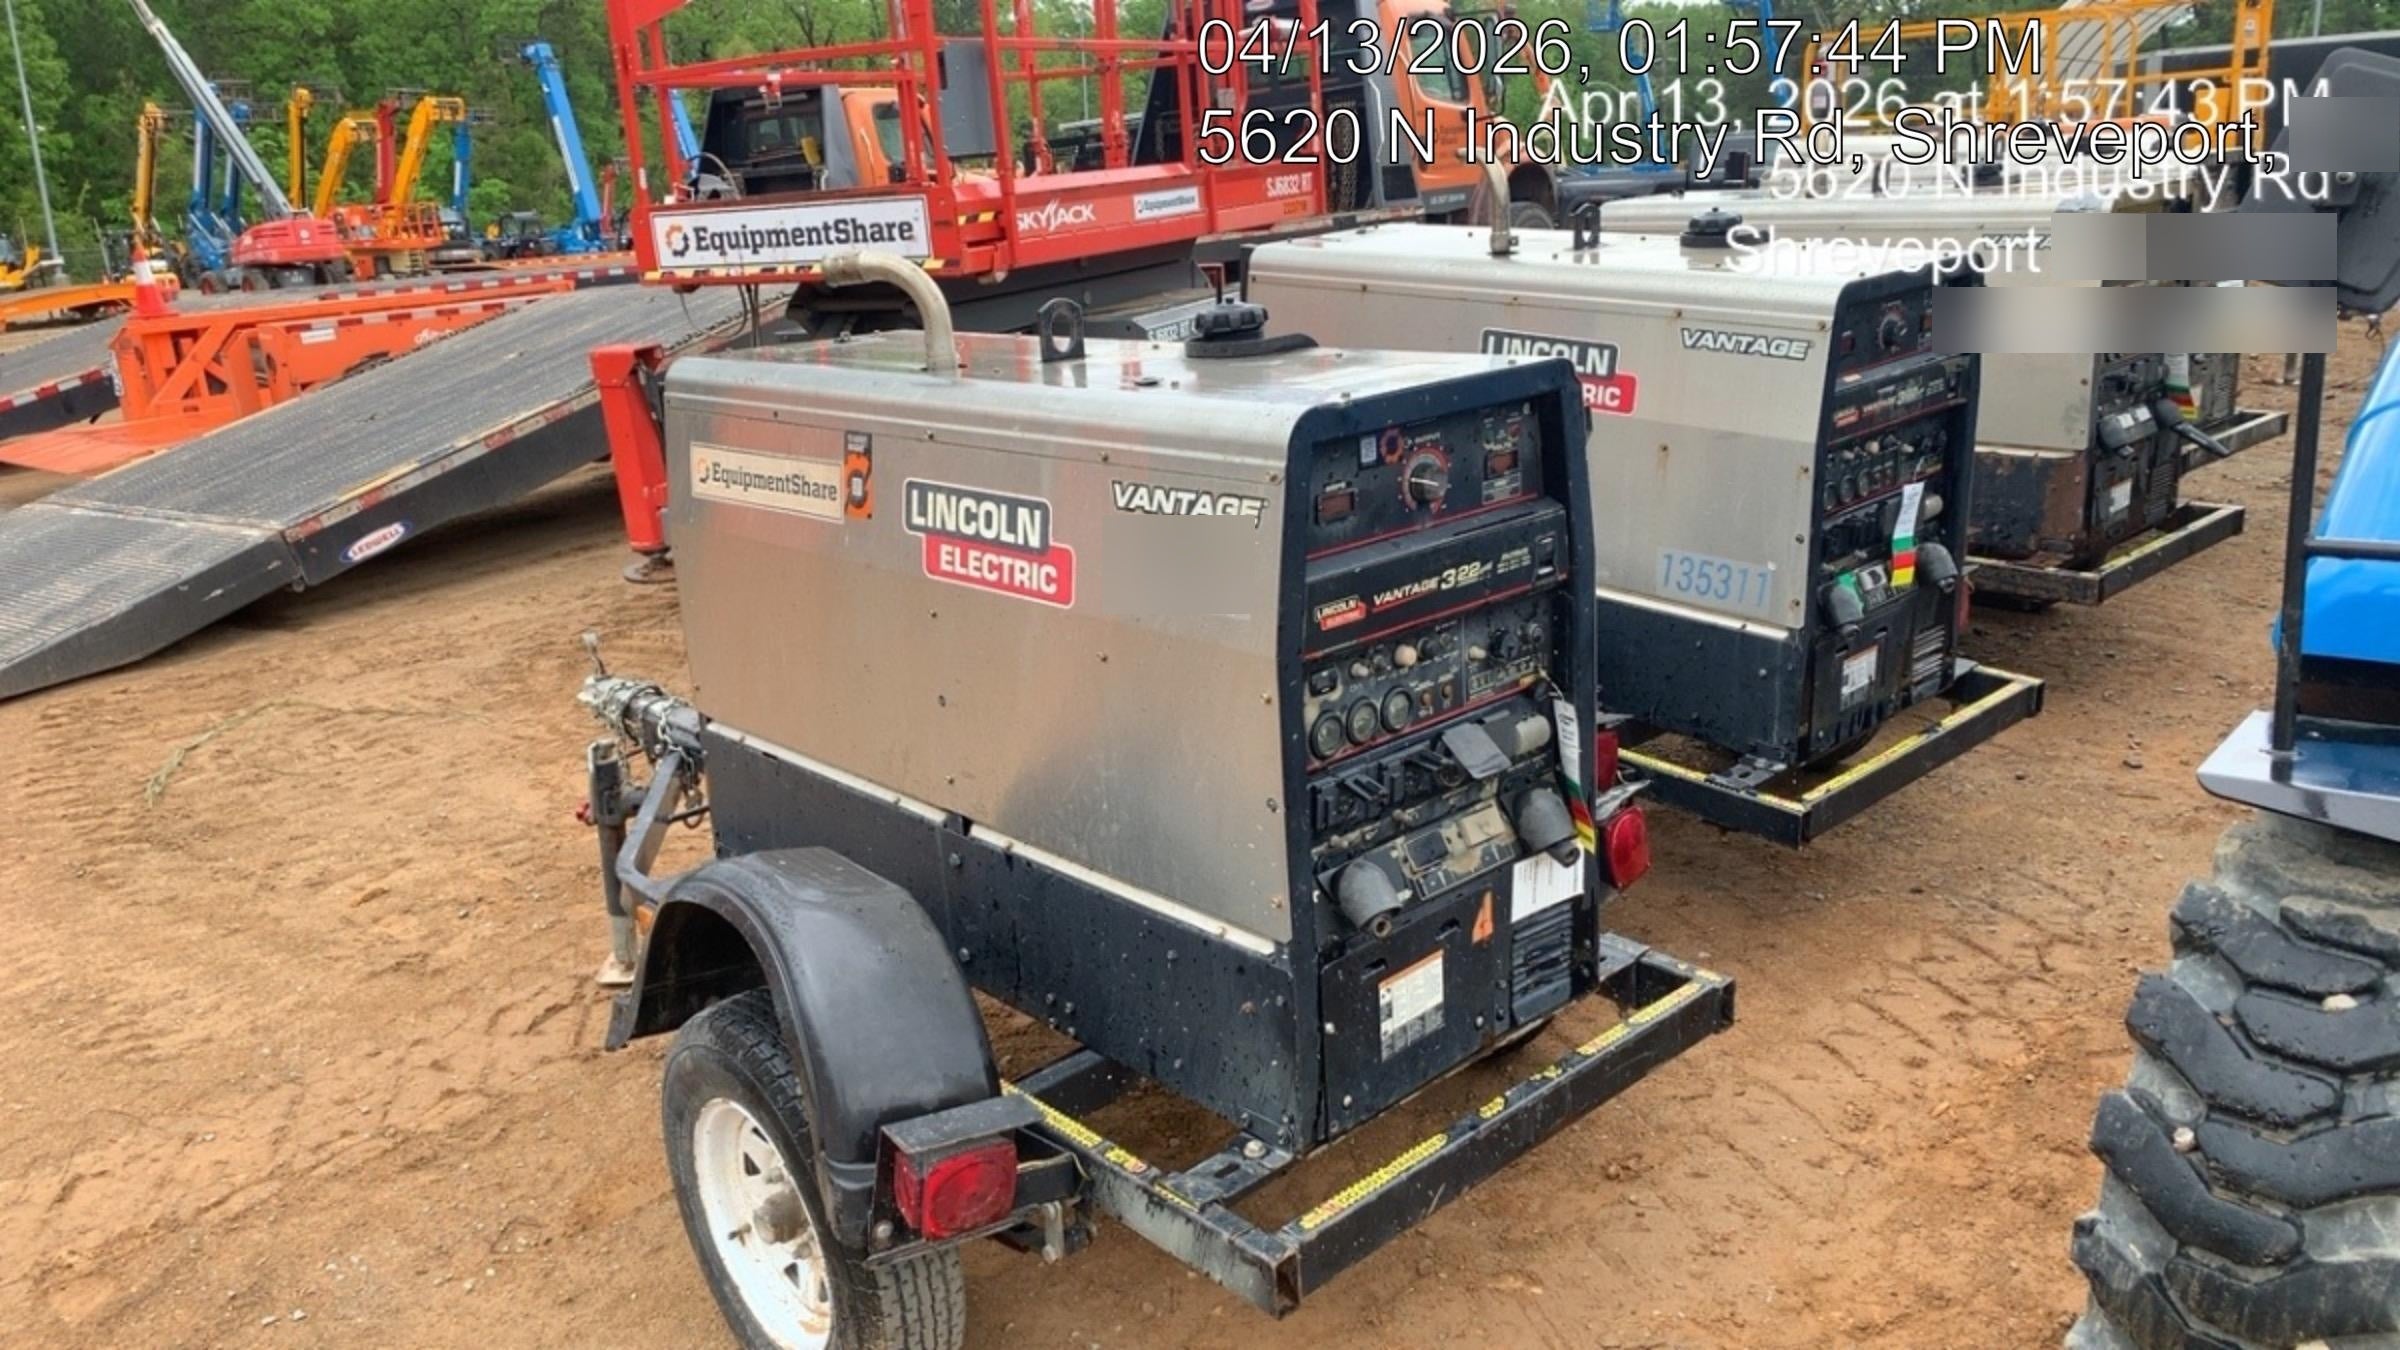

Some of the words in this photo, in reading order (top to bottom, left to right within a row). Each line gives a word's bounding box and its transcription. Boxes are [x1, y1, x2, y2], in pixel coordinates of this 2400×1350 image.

[692, 217, 914, 255] EquipmentShare
[1680, 328, 1810, 360] VANTAGE
[711, 461, 838, 501] EquipmentShare
[911, 489, 1042, 549] LINCOLN
[939, 543, 1058, 595] ELECTRIC
[1373, 576, 1440, 606] VANTAGE
[1440, 561, 1482, 590] 322
[1662, 553, 1769, 608] 135311
